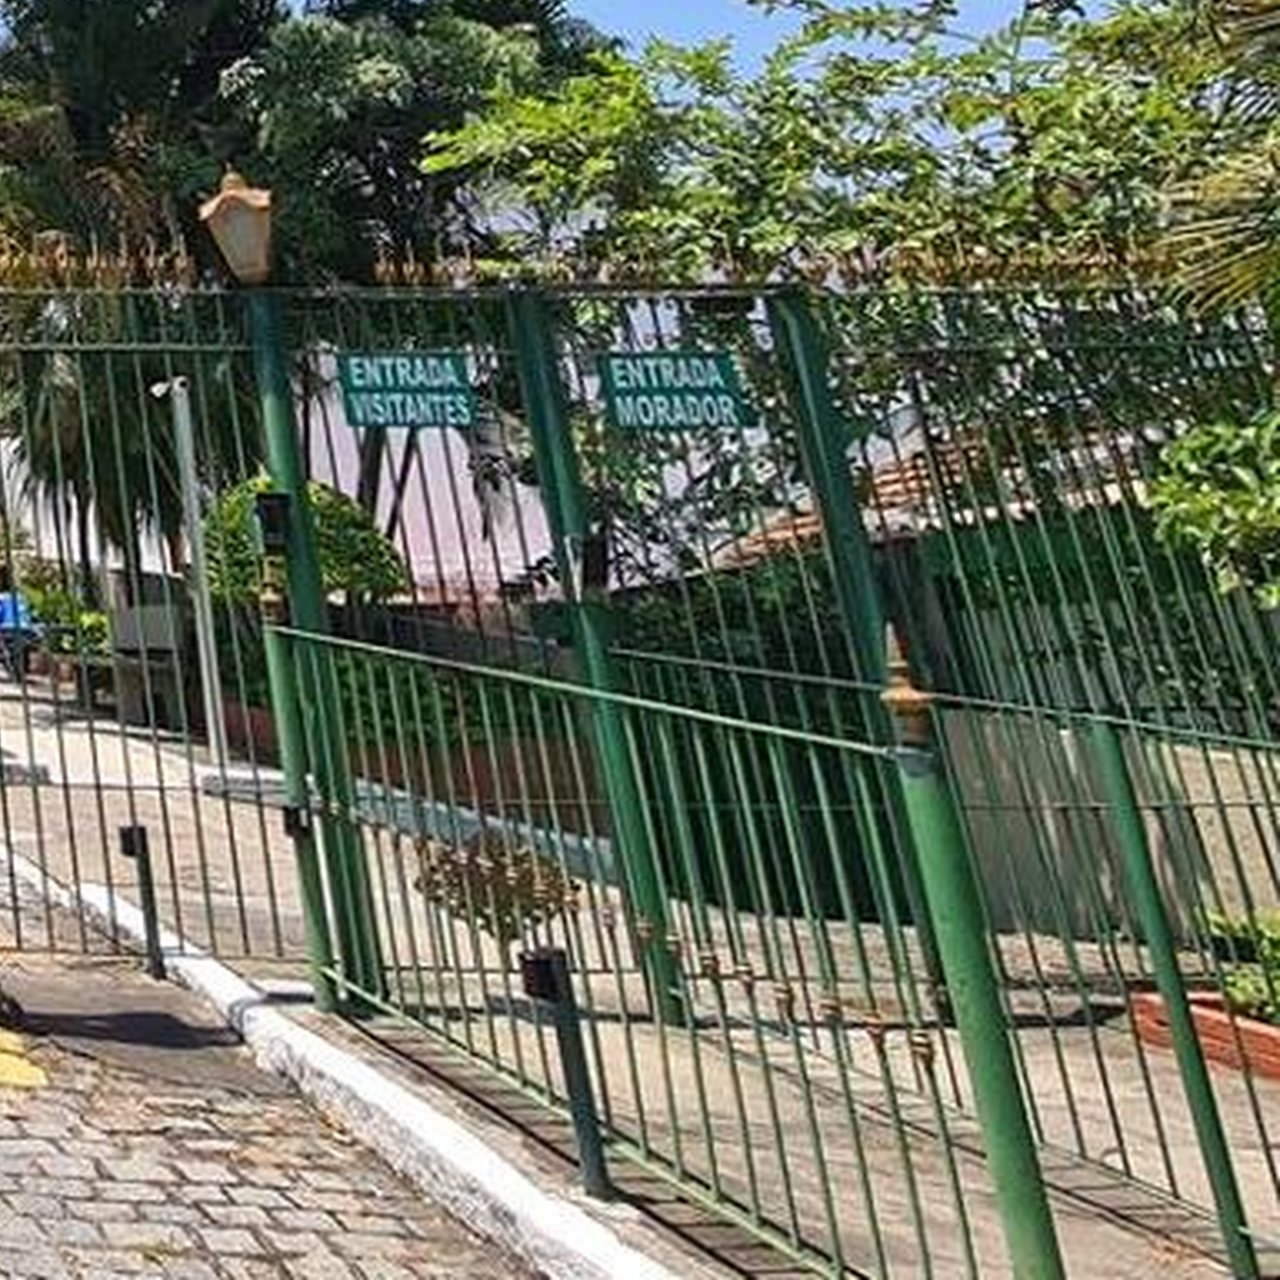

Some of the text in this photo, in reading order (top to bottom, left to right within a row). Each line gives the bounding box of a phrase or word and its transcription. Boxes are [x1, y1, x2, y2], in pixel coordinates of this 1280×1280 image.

[349, 355, 462, 388] ENTRADA
[610, 357, 725, 389] ENTRADA
[347, 392, 471, 425] VISITANTES
[615, 394, 740, 426] MORADOR
